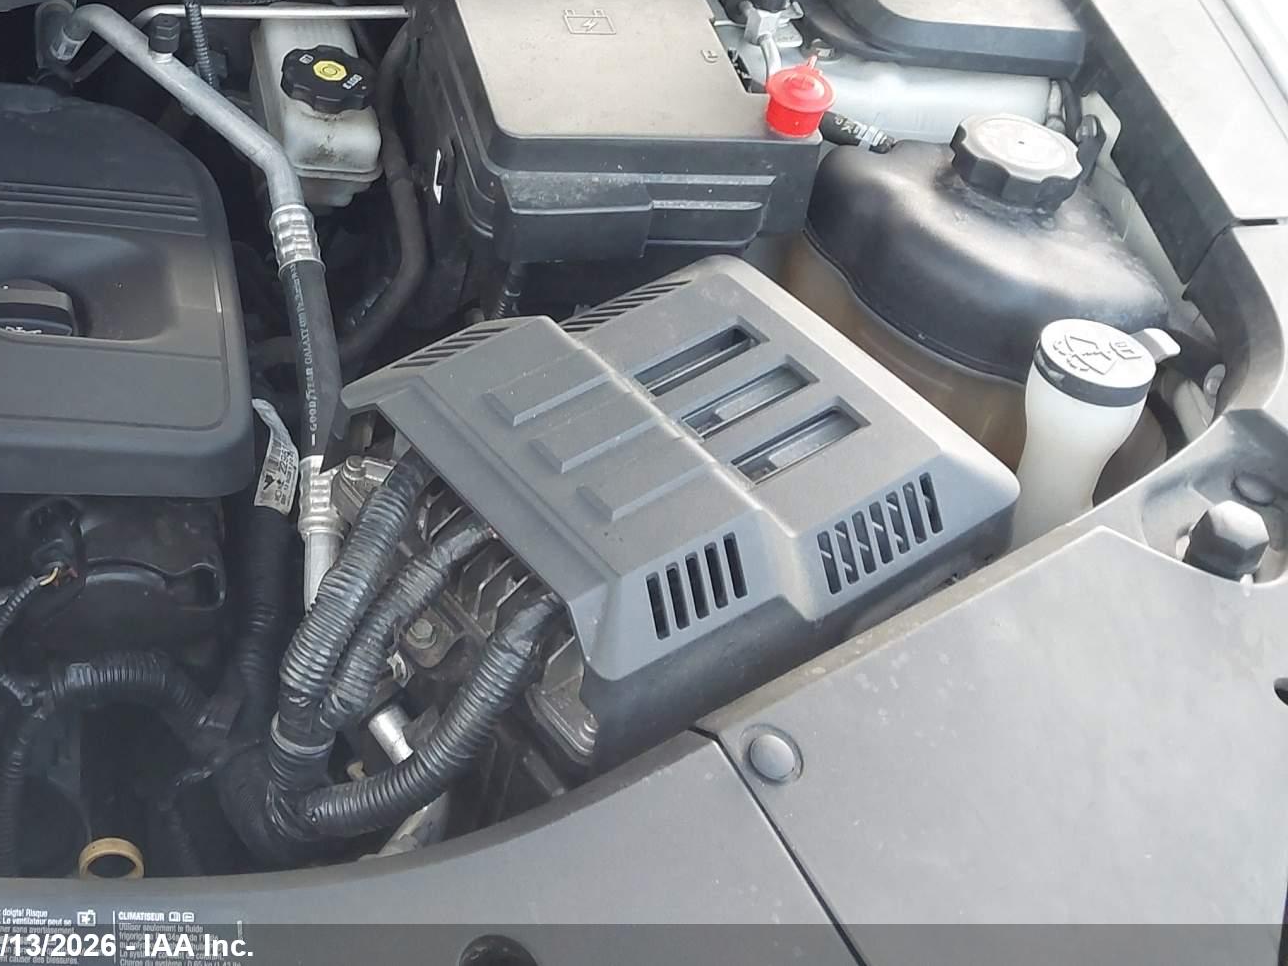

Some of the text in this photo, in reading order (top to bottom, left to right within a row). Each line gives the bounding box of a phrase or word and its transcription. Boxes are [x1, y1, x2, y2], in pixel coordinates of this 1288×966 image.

[2, 908, 24, 917] doigts!
[26, 909, 48, 918] Risque
[118, 911, 164, 921] CLIMATISEUR
[3, 916, 10, 924] Le
[12, 917, 47, 925] ventilateur
[48, 918, 62, 927] peut
[12, 926, 27, 934] sans
[185, 924, 203, 933] fluide
